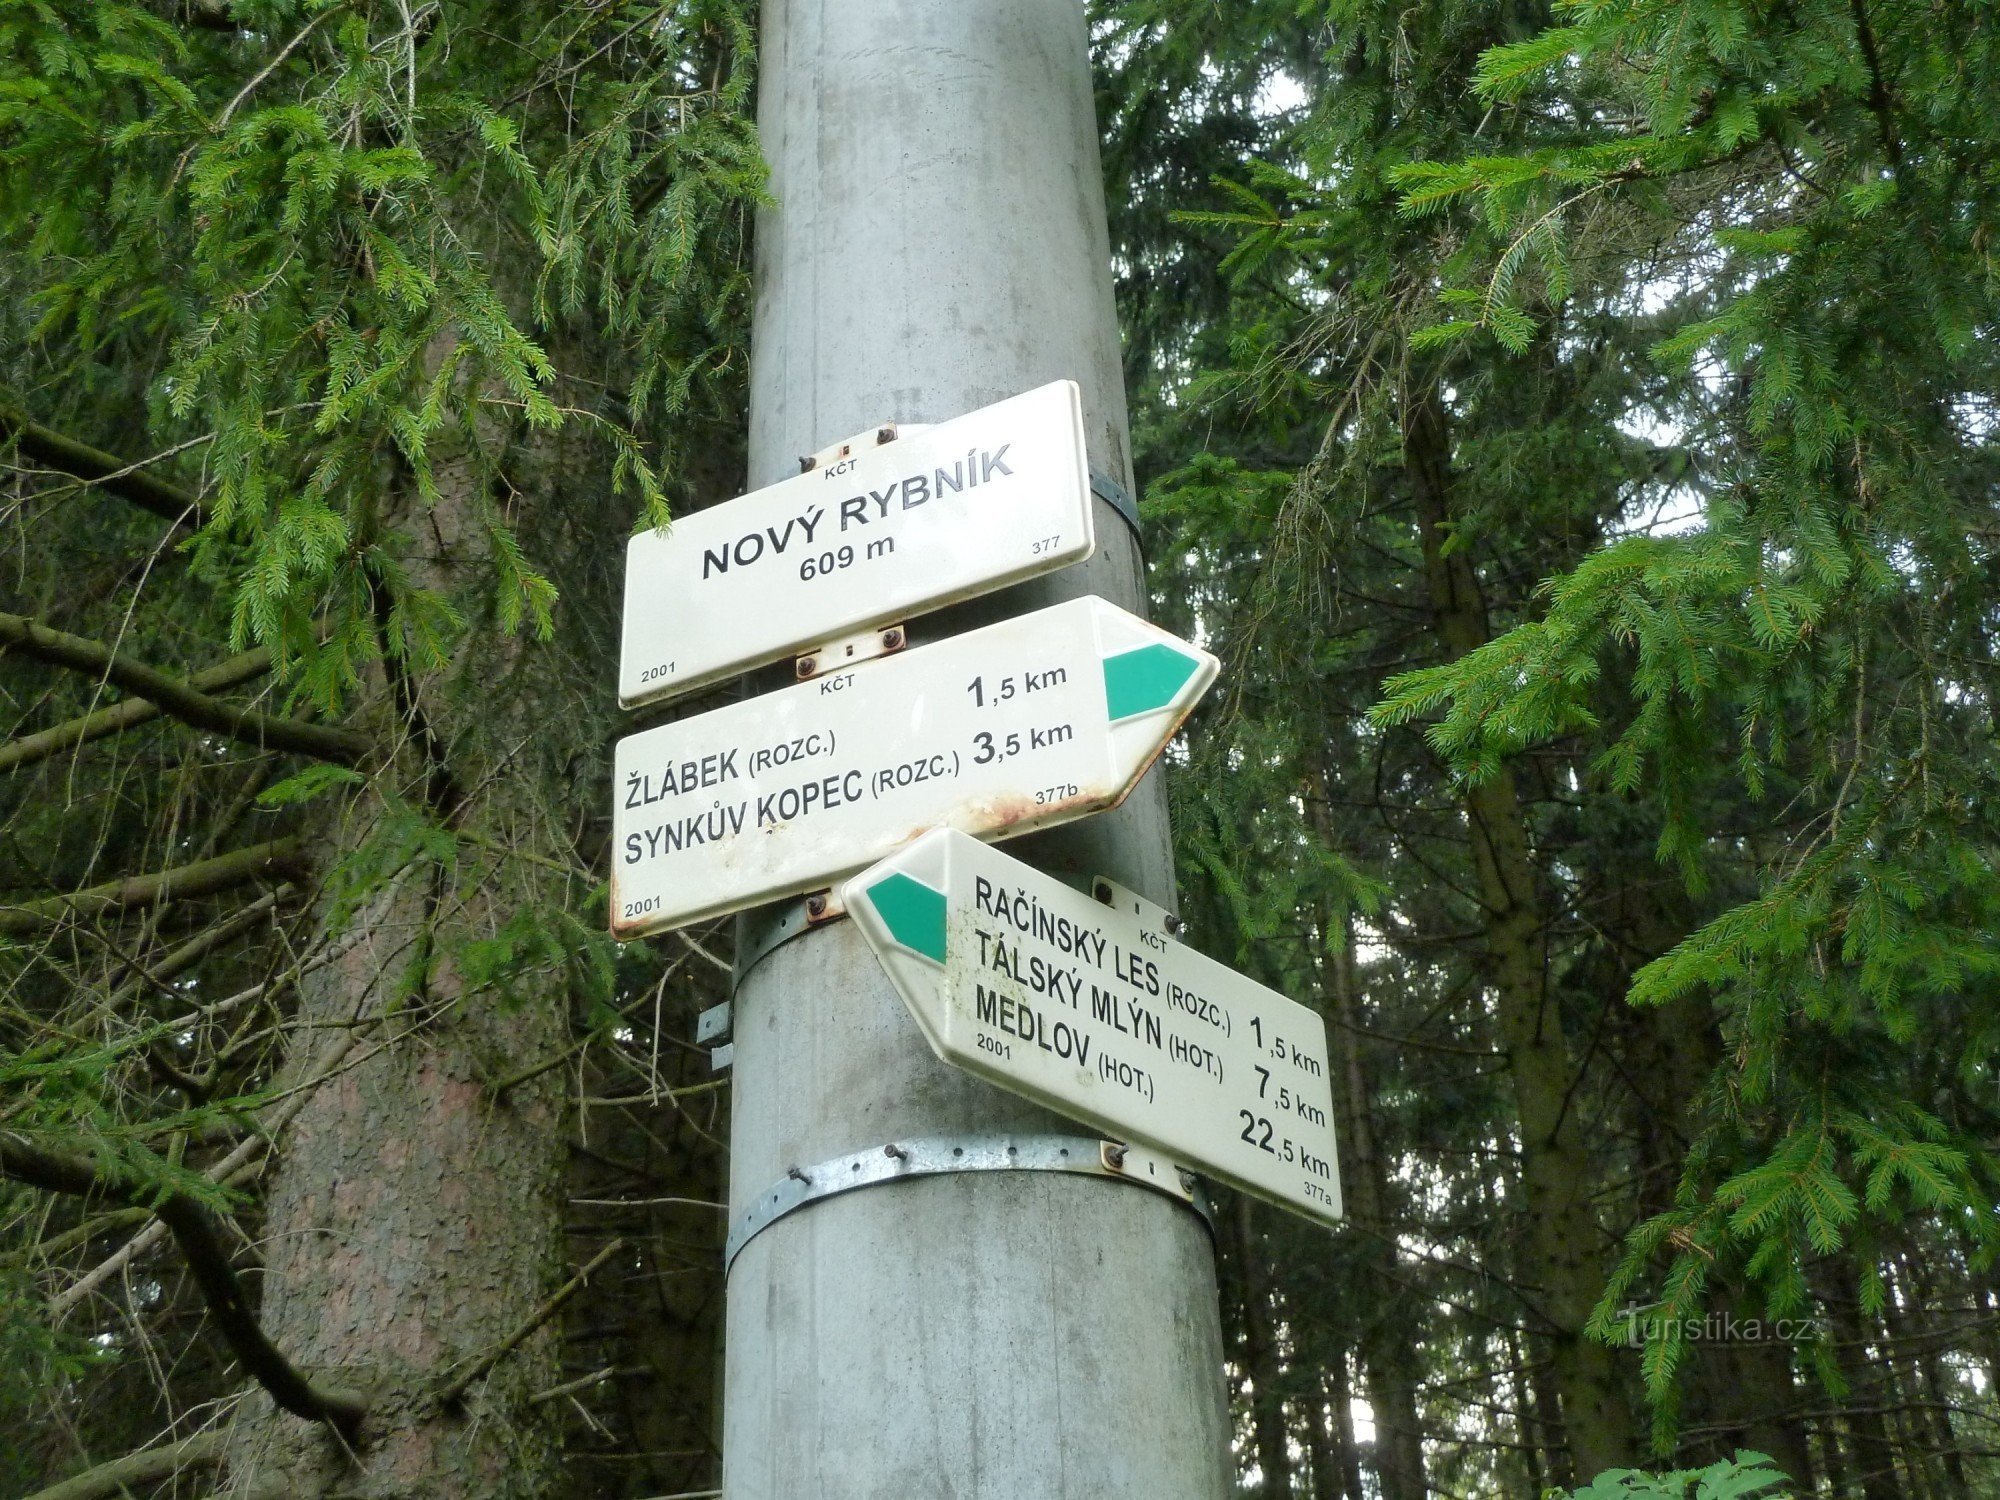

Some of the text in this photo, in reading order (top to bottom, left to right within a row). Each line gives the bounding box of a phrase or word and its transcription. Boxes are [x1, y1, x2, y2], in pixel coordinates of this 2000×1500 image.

[825, 459, 857, 480] KČT
[702, 444, 1013, 580] NOVÝ RYBNÍK
[1032, 535, 1060, 555] 377
[800, 536, 894, 581] 609 m
[641, 662, 676, 682] 2001
[820, 674, 855, 696] KČT
[625, 665, 1067, 810] ŽLÁBEK (ROZC.) 1,5 km
[625, 723, 1073, 864] SYNKŮV KOPEC (ROZC.) 3,5 km
[1035, 784, 1078, 805] 377b
[625, 896, 661, 918] 2001
[1140, 929, 1167, 953] KČT
[976, 875, 1321, 1077] RAČÍNSKÝ LES (ROZC.) 1,5 km
[975, 929, 1325, 1127] TÁLSKÝ MLÝN (HOT.) 7,5 km
[977, 1034, 1011, 1060] 2001
[976, 985, 1330, 1179] MEDLOV (HOT.) 22,5 km
[1304, 1183, 1332, 1206] 377a
